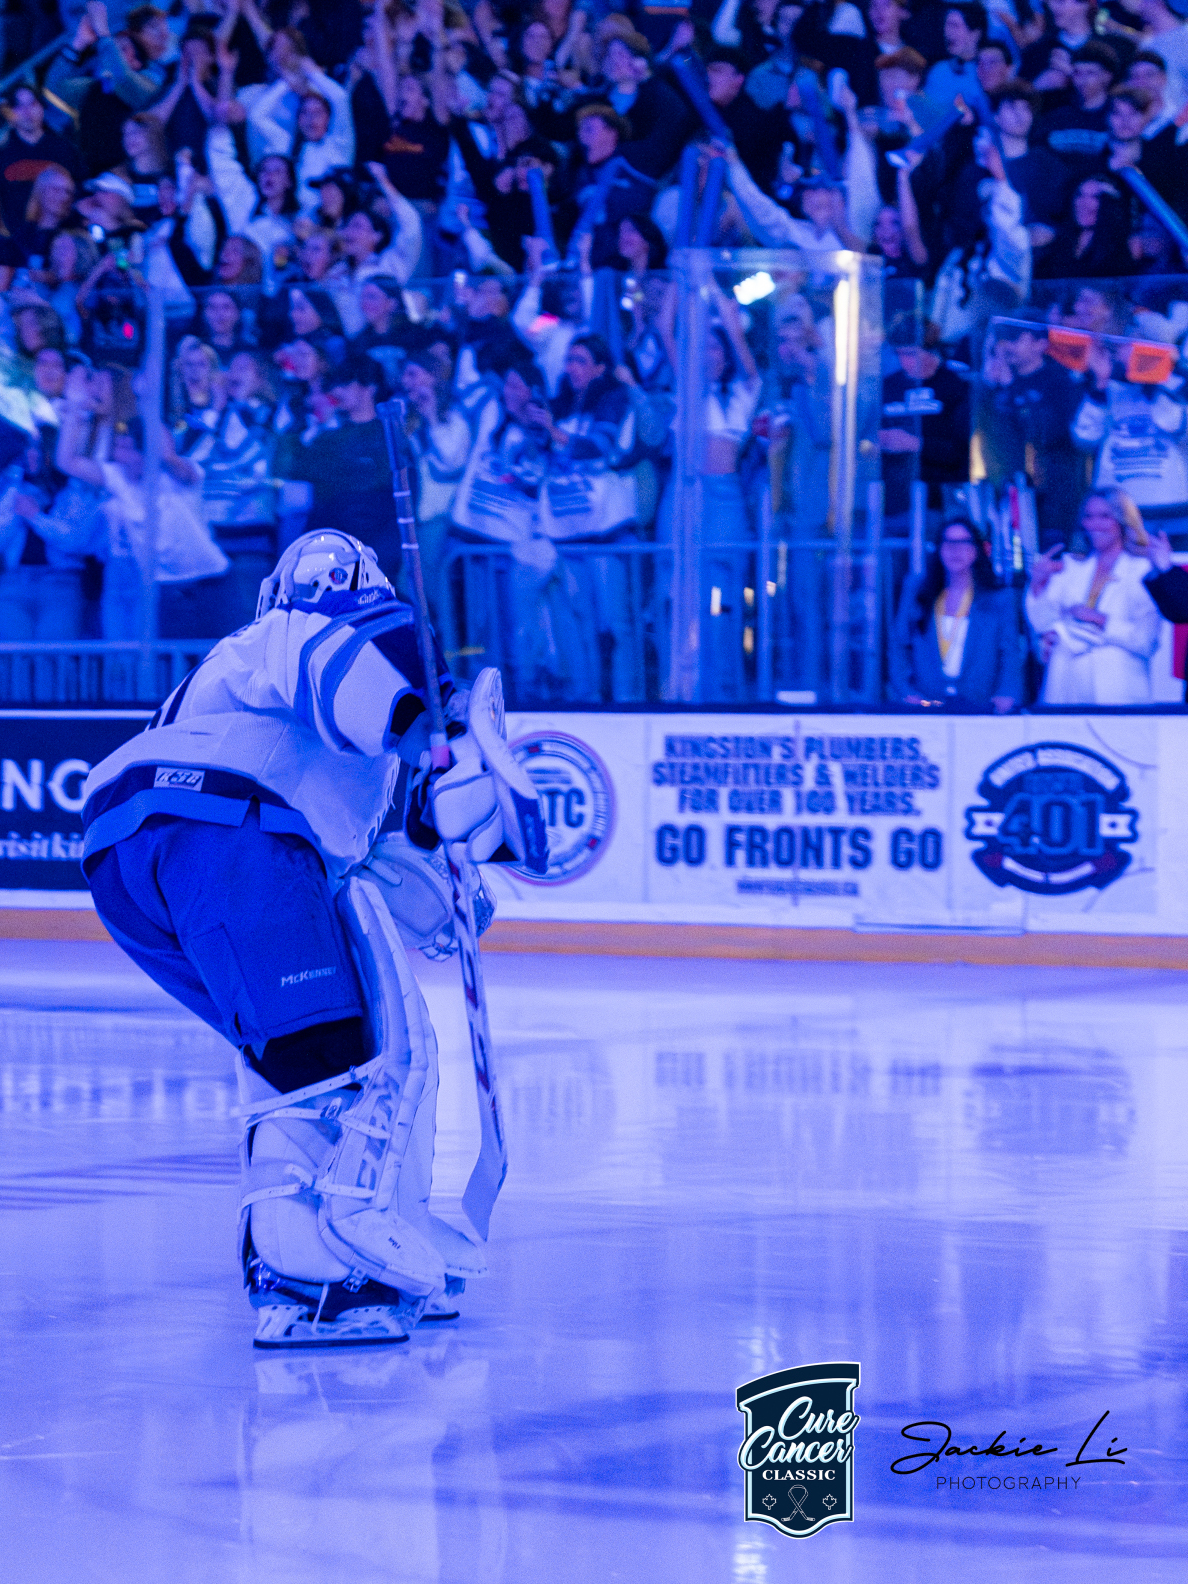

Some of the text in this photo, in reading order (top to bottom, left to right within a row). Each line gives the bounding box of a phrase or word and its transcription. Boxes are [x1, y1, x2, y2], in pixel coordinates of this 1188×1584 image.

[840, 763, 941, 790] WELDERS
[677, 787, 720, 814] FOR
[727, 788, 783, 815] OVER
[997, 792, 1106, 856] 401
[655, 823, 707, 868] GO
[724, 823, 873, 870] FRONTS
[890, 826, 945, 872] GO
